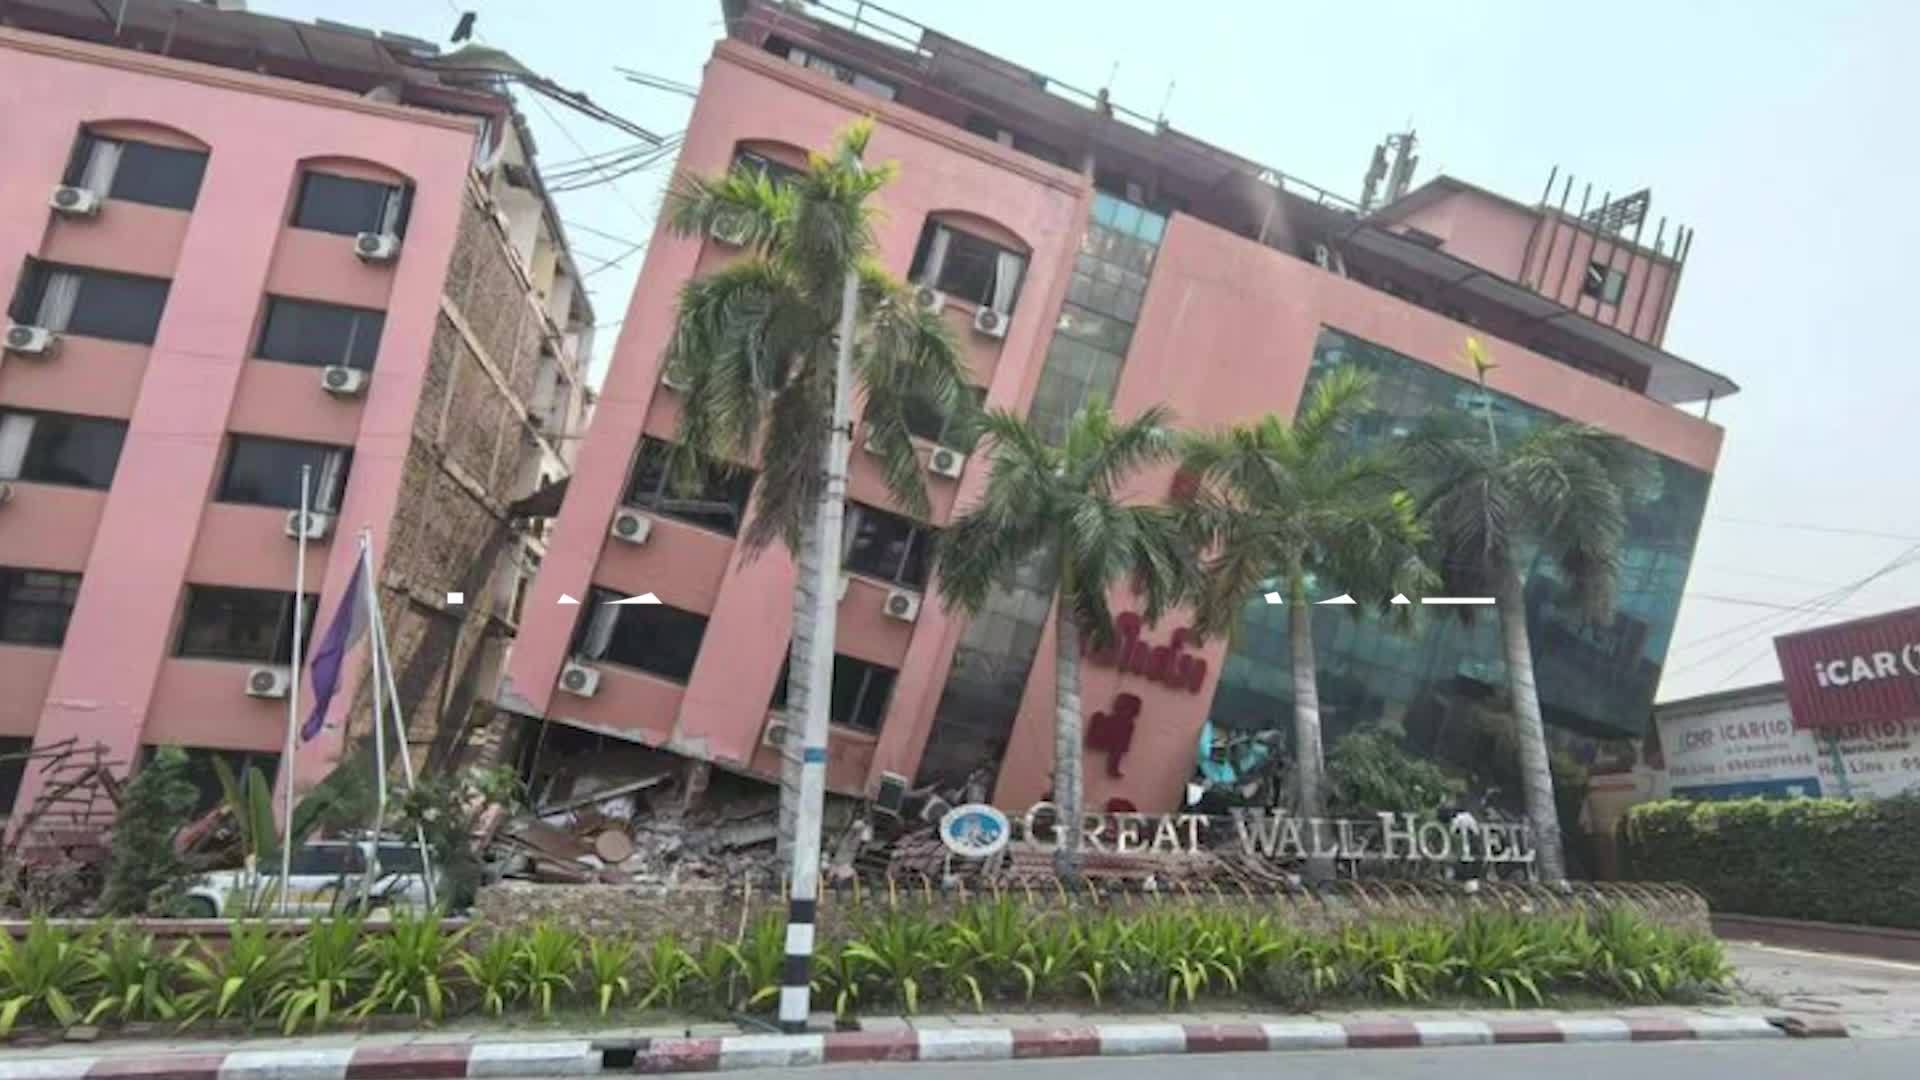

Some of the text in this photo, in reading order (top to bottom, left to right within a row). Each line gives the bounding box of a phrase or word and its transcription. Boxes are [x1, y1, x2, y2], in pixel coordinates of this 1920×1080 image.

[1814, 651, 1898, 687] iCAR
[1024, 801, 1536, 863] GREAT WALL HOTEL
